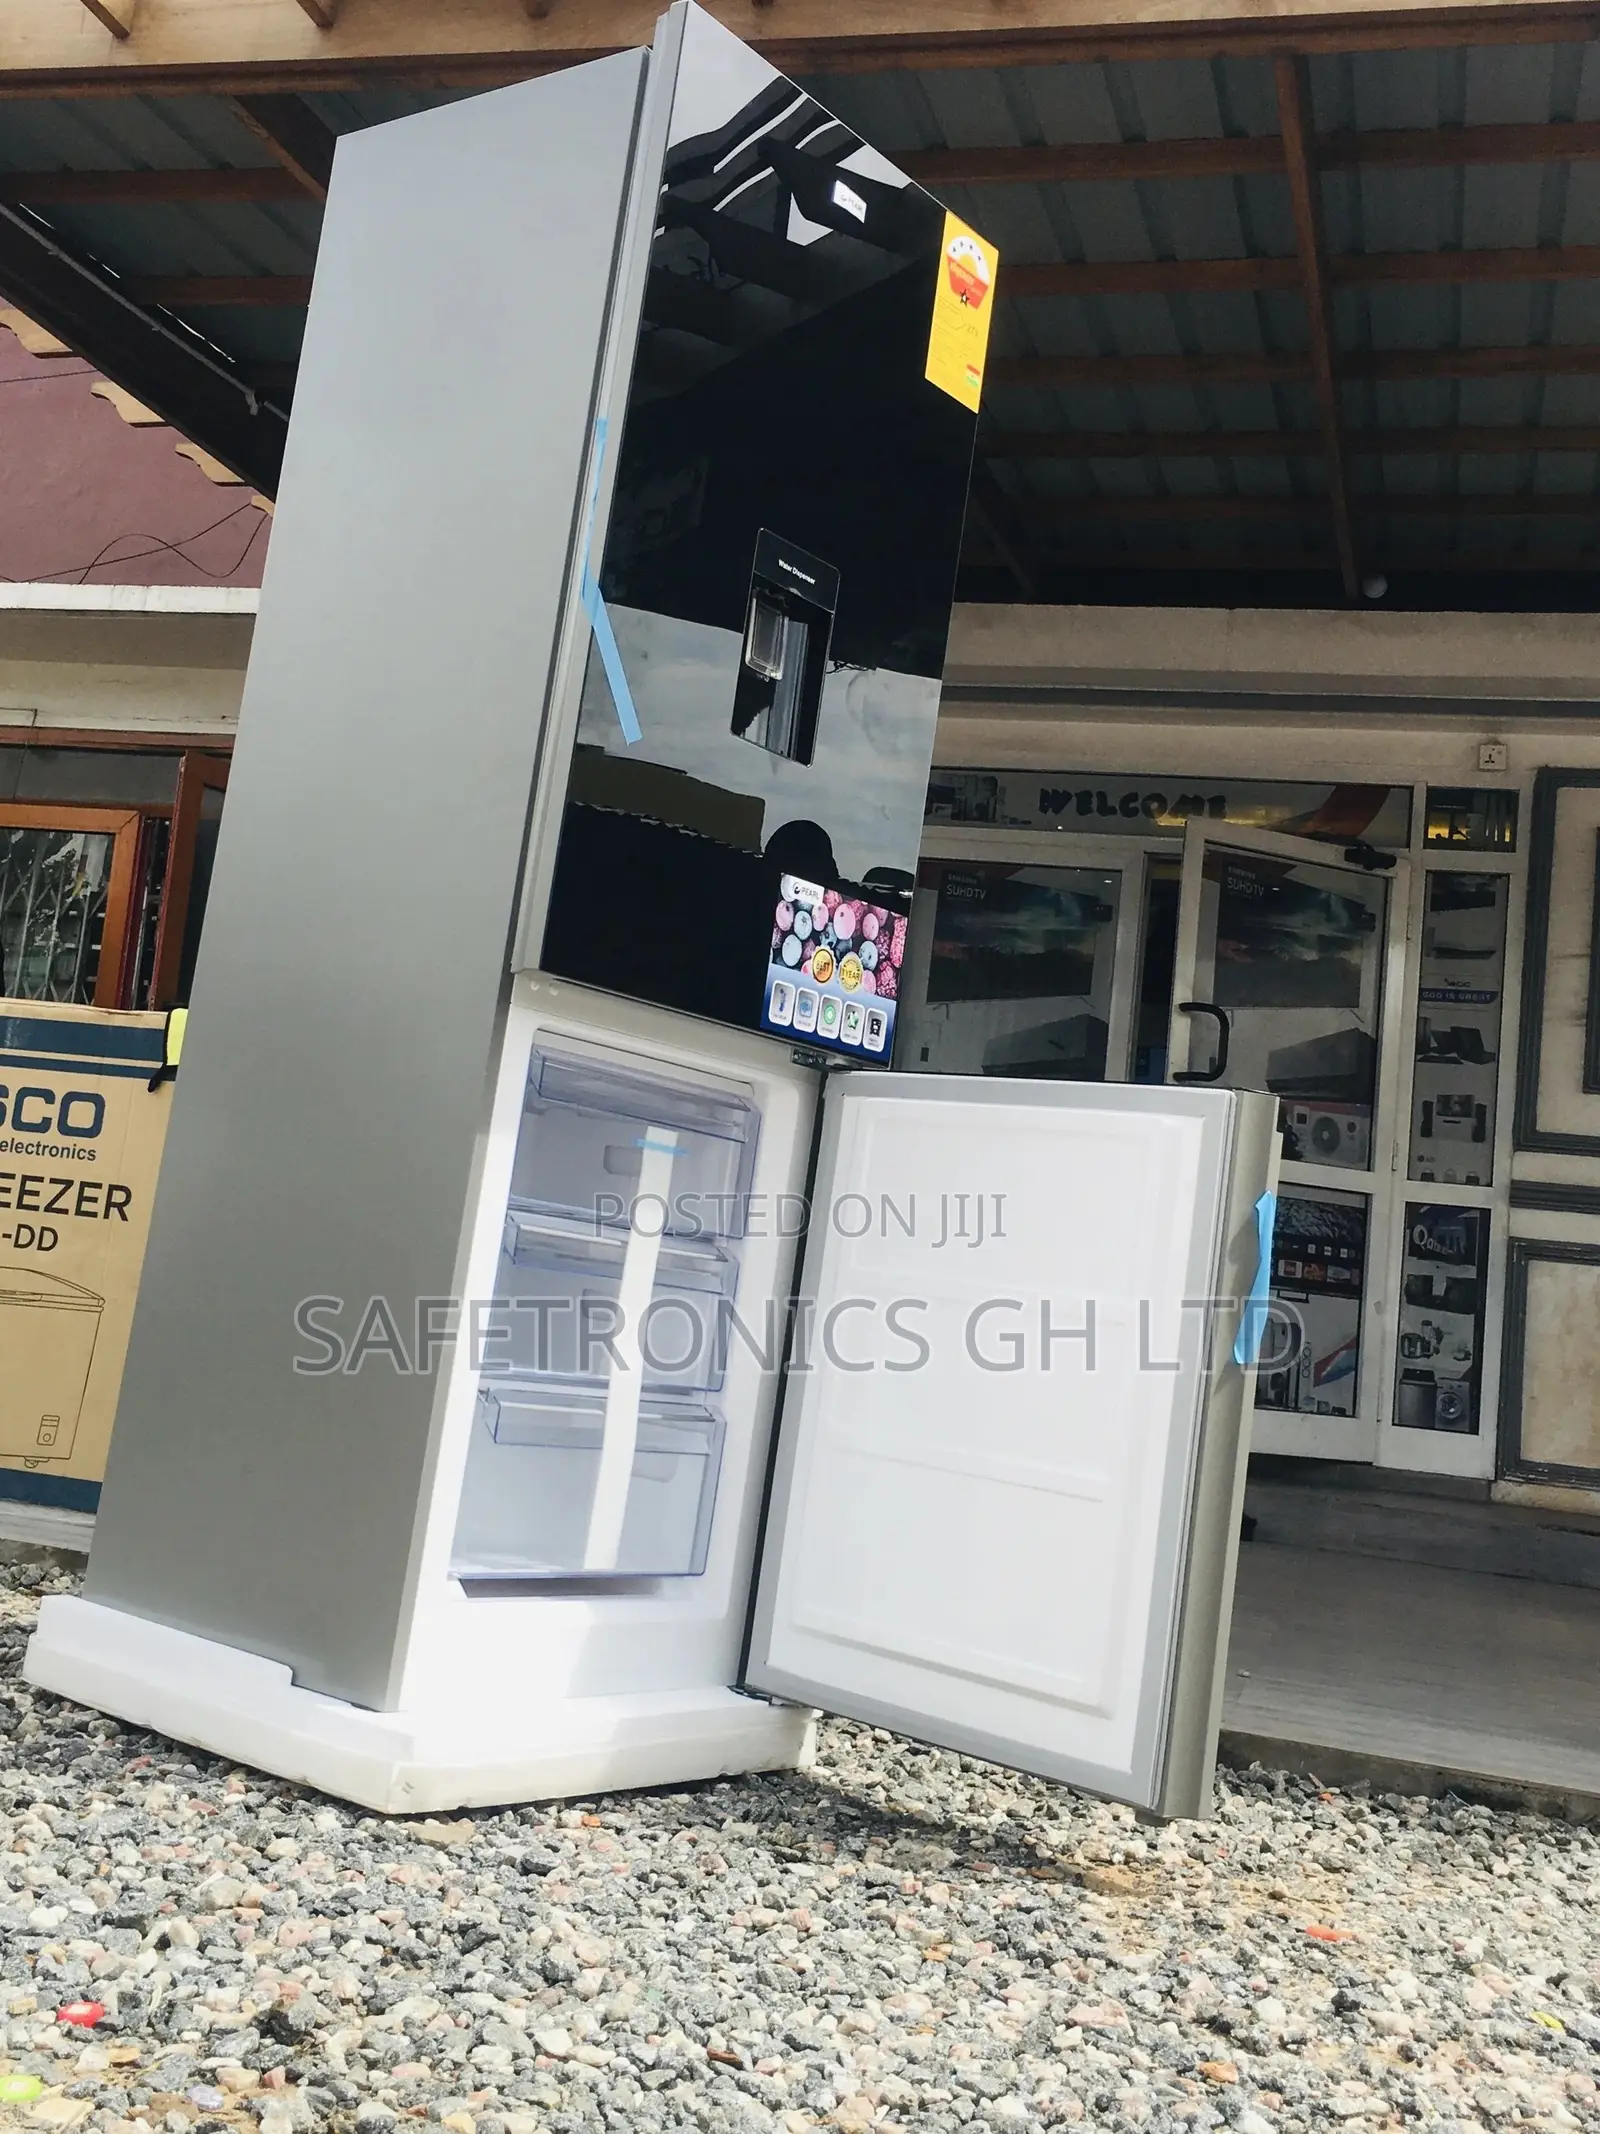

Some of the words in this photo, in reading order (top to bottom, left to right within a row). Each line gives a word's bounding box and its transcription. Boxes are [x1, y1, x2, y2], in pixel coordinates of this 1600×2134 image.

[1039, 788, 1227, 819] WELCOME
[801, 886, 820, 900] PEARL
[0, 1084, 106, 1139] CO
[0, 1138, 97, 1161] electronics
